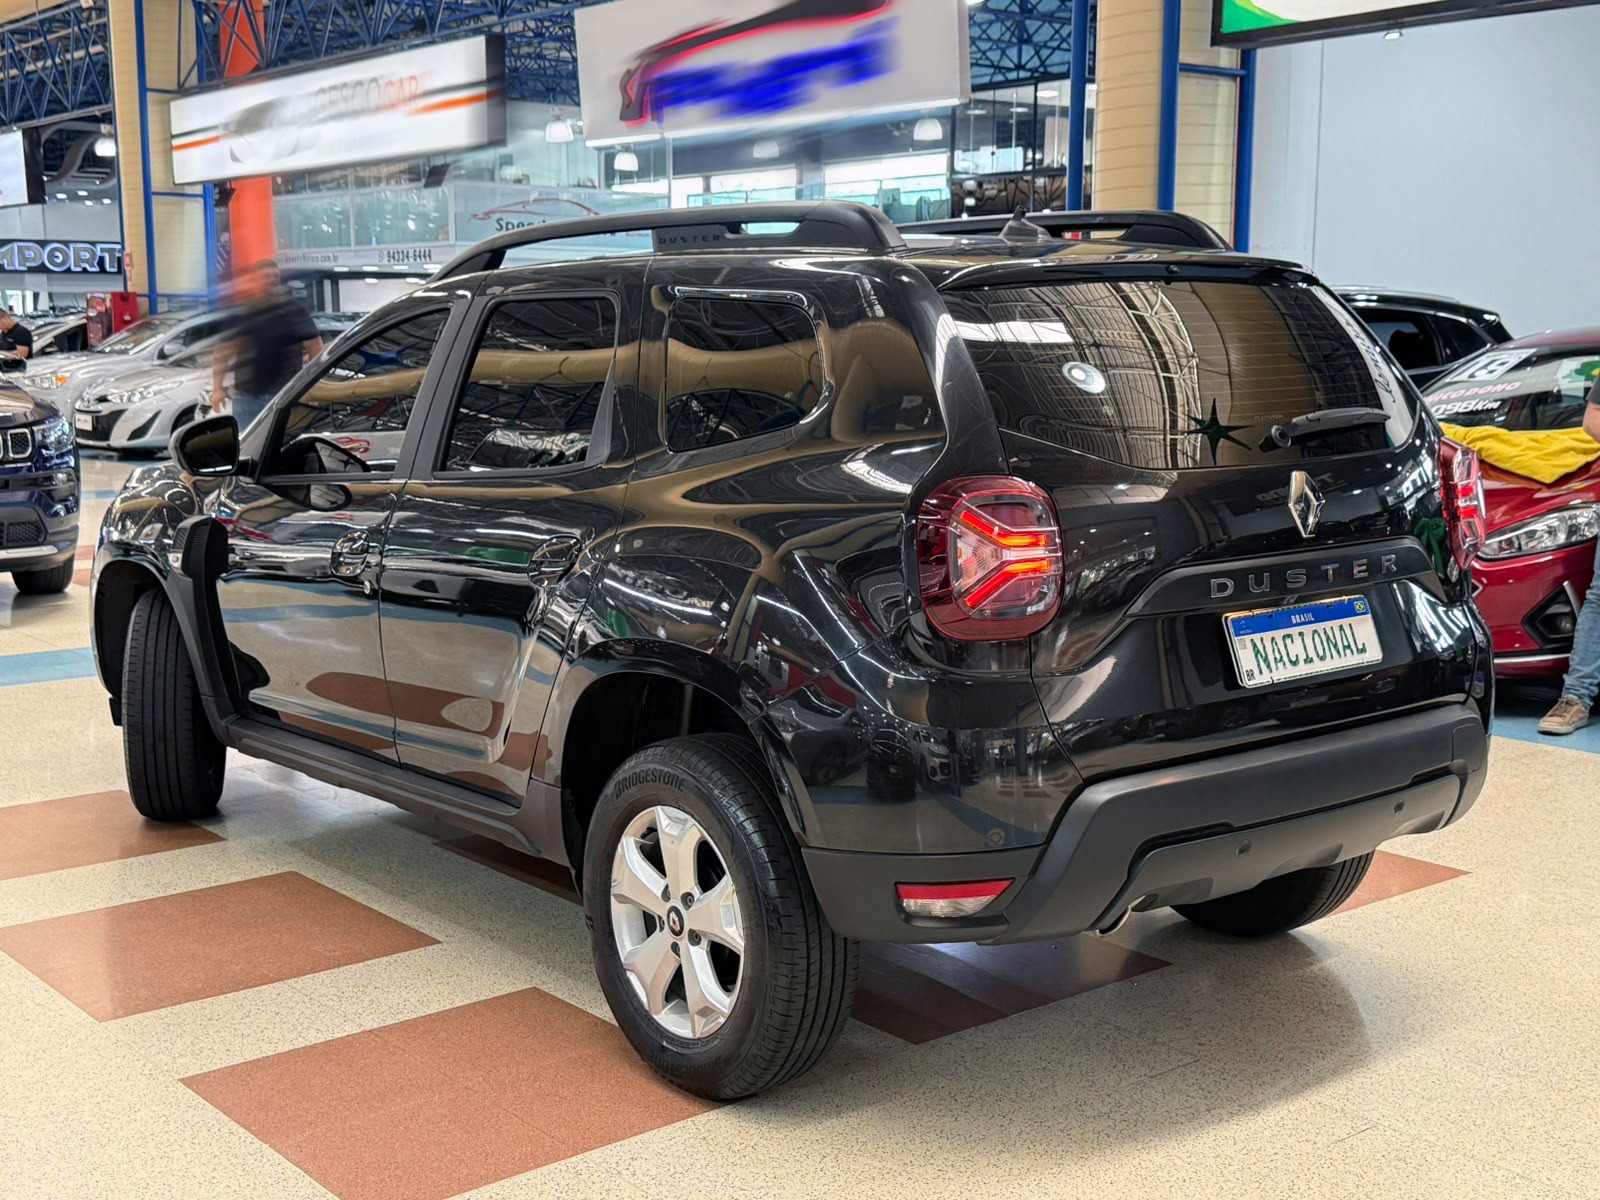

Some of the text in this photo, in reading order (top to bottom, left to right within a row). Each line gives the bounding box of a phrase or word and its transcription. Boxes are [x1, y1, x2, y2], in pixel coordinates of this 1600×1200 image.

[658, 234, 721, 245] DUSTER
[1210, 553, 1398, 599] DUSTER
[1291, 612, 1315, 625] BRASIL
[1249, 623, 1368, 676] NACIONAL
[1245, 669, 1256, 683] BR
[613, 767, 686, 801] BRIDGESTONE
